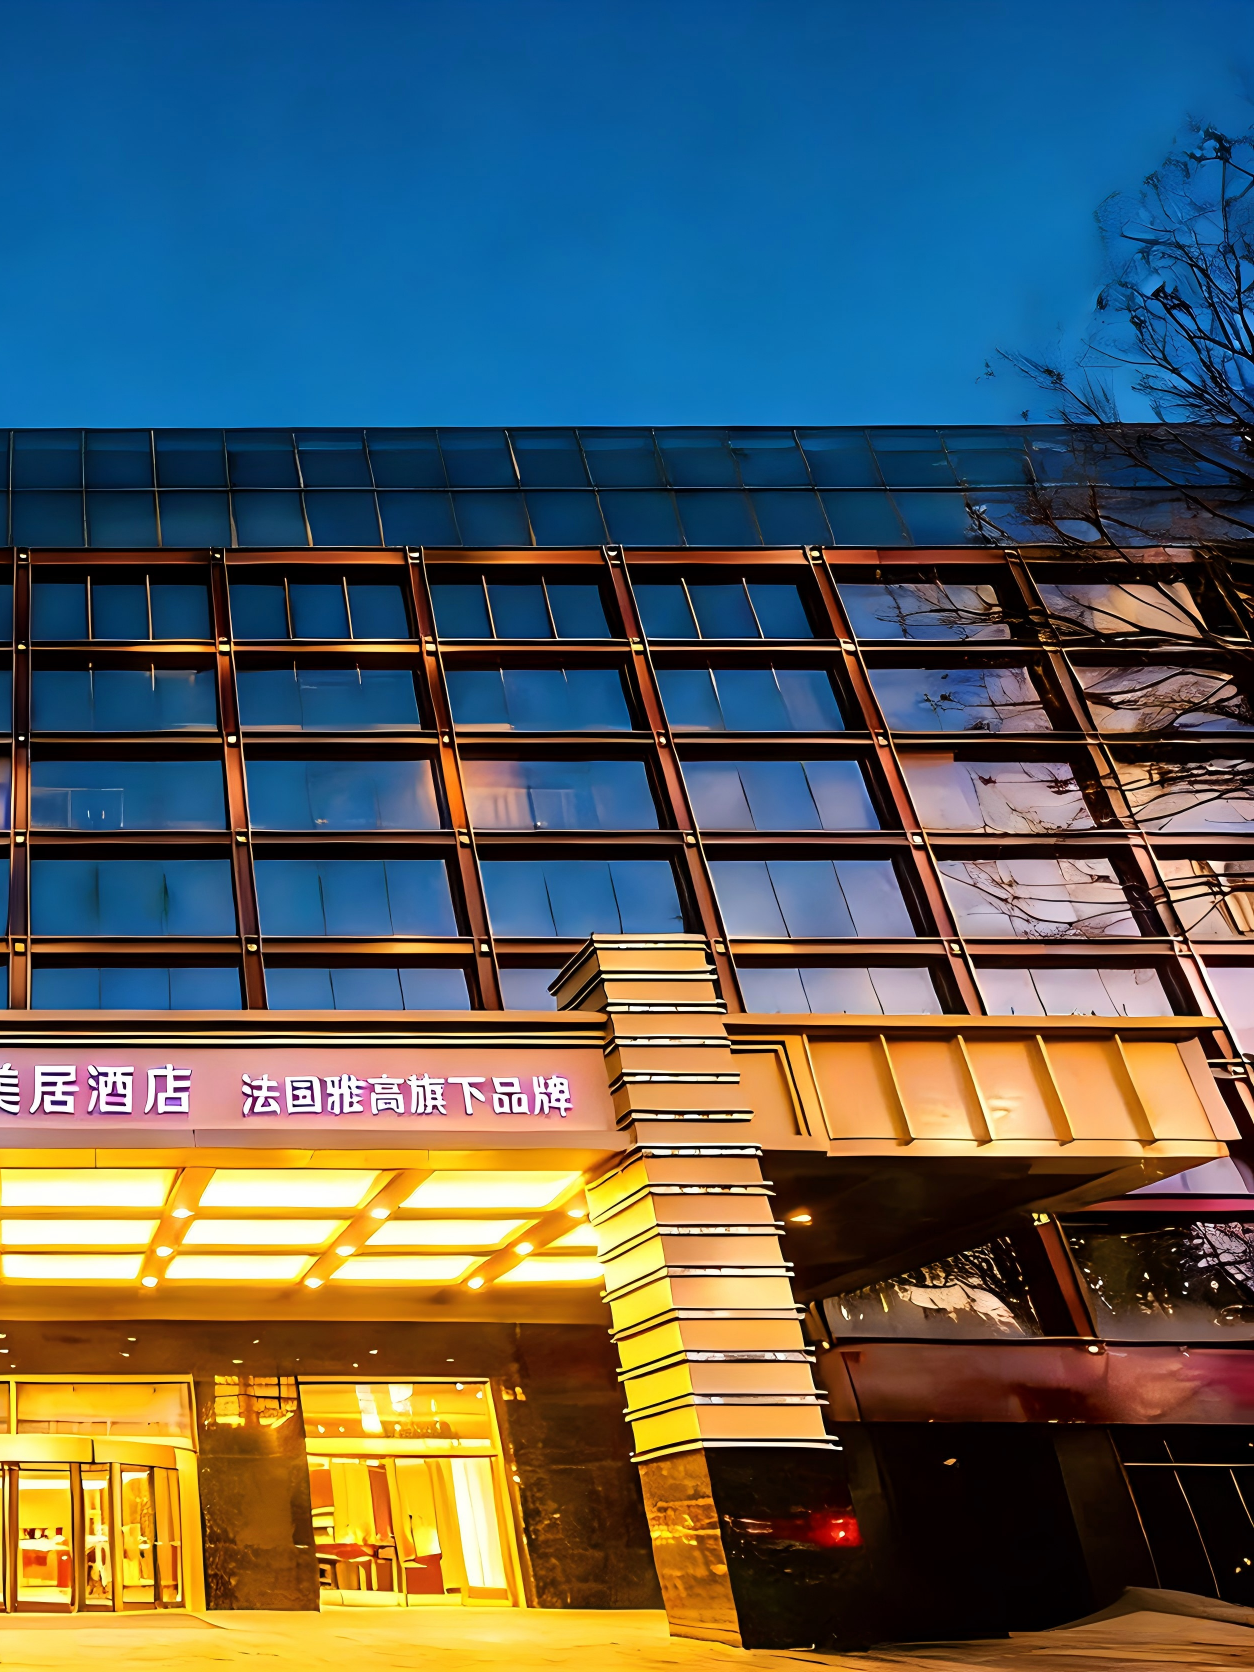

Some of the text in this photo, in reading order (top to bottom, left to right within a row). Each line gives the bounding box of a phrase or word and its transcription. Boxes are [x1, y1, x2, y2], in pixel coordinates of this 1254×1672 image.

[241, 1072, 574, 1118] 法国雅高旗下品牌
